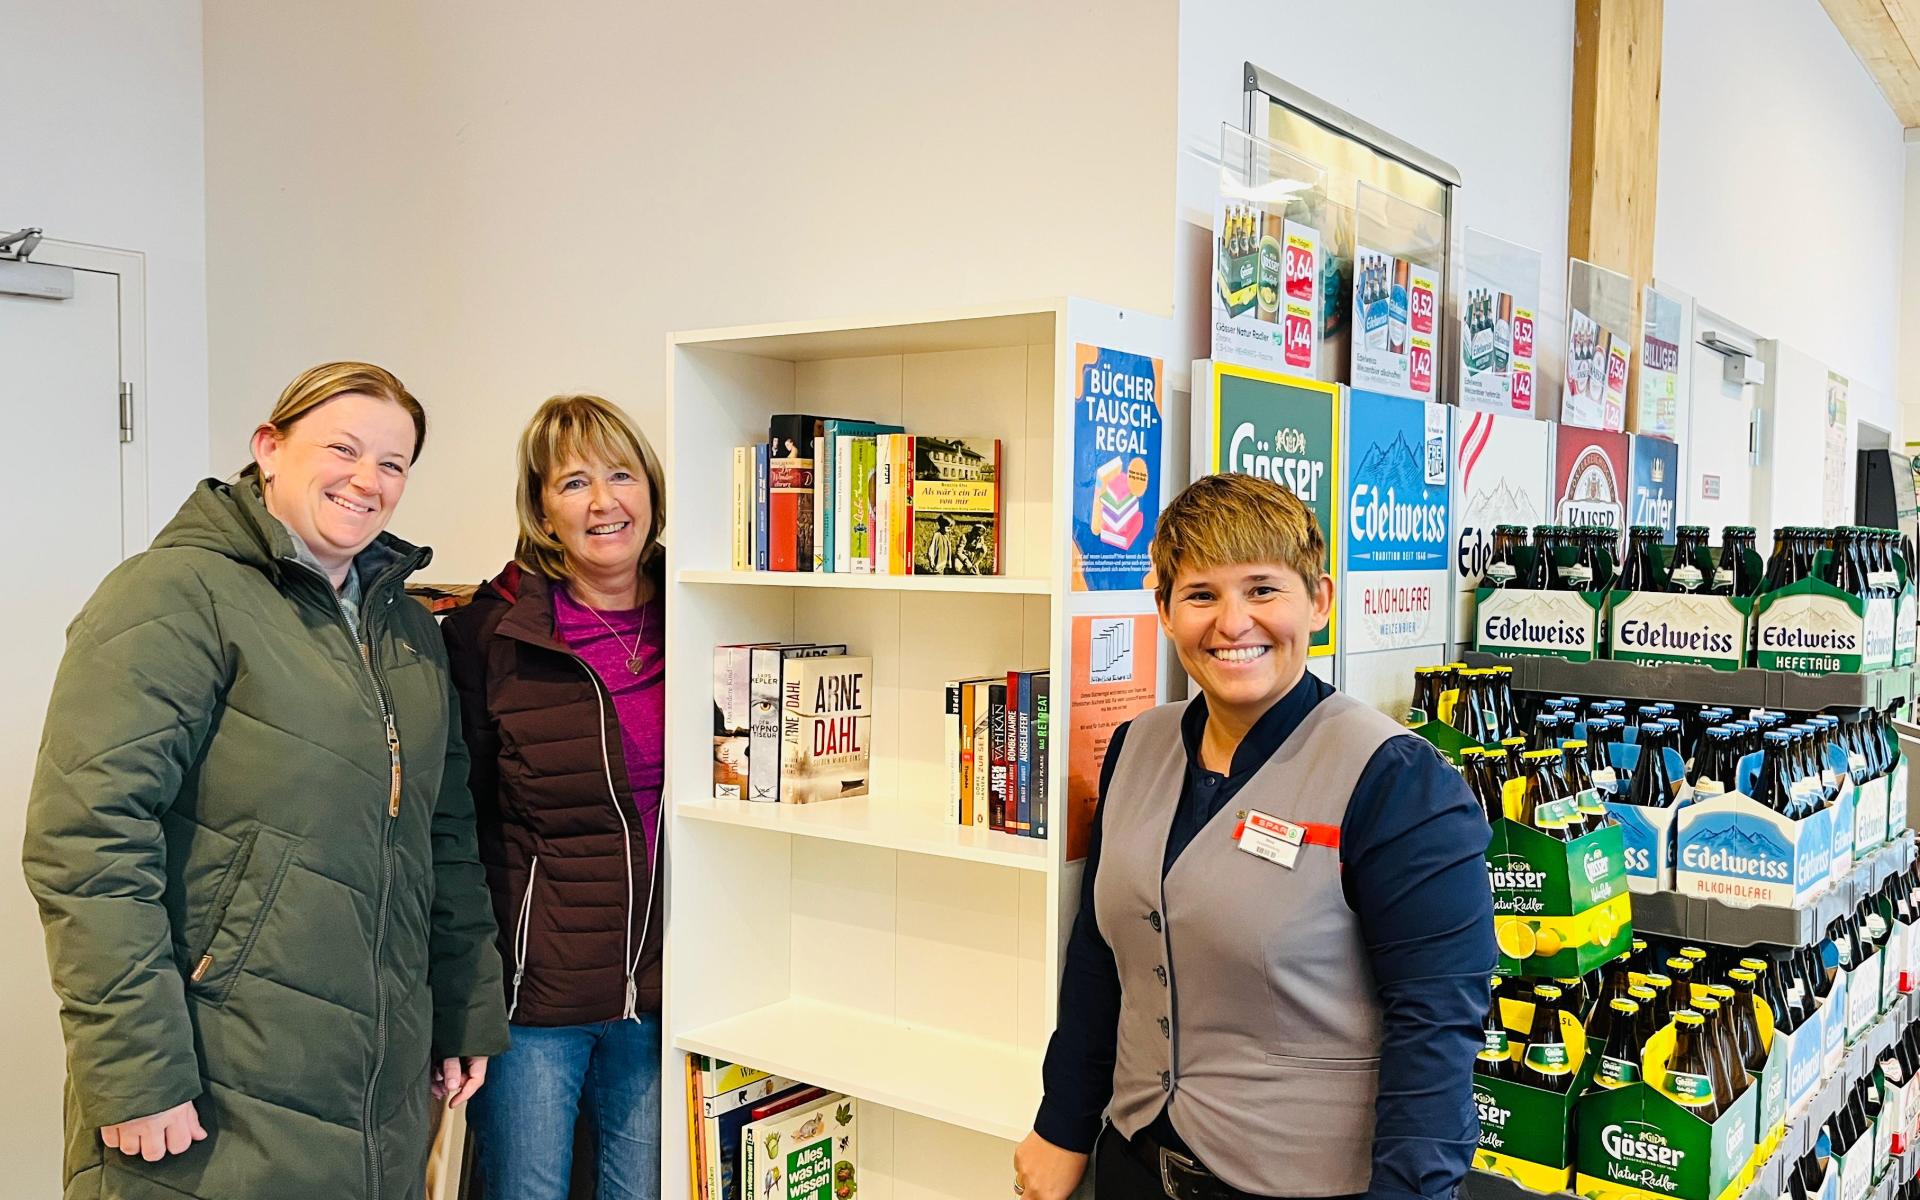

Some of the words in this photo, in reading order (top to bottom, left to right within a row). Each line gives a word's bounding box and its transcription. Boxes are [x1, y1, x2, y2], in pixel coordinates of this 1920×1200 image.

[1286, 250, 1313, 282] 8,64
[1412, 292, 1432, 318] 8,52
[1286, 319, 1311, 351] 1,44
[1514, 320, 1532, 345] 8,52
[1411, 350, 1431, 377] 1,42
[1643, 342, 1678, 375] BILLIGER
[1090, 364, 1155, 402] BÜCHER
[1512, 373, 1531, 398] 1,42
[1086, 396, 1158, 428] TAUSCH-
[1096, 425, 1148, 455] REGAL
[1229, 422, 1324, 502] Gösser
[921, 487, 935, 496] Als
[936, 488, 956, 496] wär's
[958, 489, 970, 497] ein
[973, 489, 988, 497] Teil
[1350, 484, 1446, 544] Edelweiss
[1568, 507, 1615, 529] KAISER
[1636, 486, 1673, 531] Zipfer
[1372, 551, 1400, 561] TRADITION
[1402, 551, 1414, 561] SEIT
[1364, 586, 1431, 615] ALKOHOLFREI
[1380, 621, 1416, 635] WEIZENBIER
[1485, 615, 1586, 646] Edelweiss
[1620, 620, 1733, 653] Edelweiss
[1762, 625, 1857, 650] Edelweiss
[1775, 654, 1841, 672] HEFETRÜB
[786, 680, 800, 708] DAHL
[814, 673, 863, 714] ARNE
[750, 725, 778, 733] HYPNO
[1037, 694, 1048, 737] RETREAT
[785, 716, 799, 745] ARNE
[813, 716, 861, 757] DAHL
[994, 704, 1004, 761] VATIKAN
[1007, 710, 1017, 762] BOMBENJAHRE
[1019, 711, 1029, 763] AUSGELIEFERT
[991, 765, 1000, 792] RICK
[998, 765, 1007, 801] JONES
[1258, 818, 1288, 835] SPAR
[1623, 847, 1649, 871] ss
[1682, 842, 1789, 880] Edelweiss
[1492, 896, 1545, 914] aturRadler
[1697, 880, 1773, 901] ALKOHOLFREI
[796, 1146, 824, 1168] Alles
[1601, 1124, 1686, 1167] Gösser
[788, 1165, 813, 1185] was
[814, 1157, 831, 1175] ich
[790, 1172, 830, 1199] wissen
